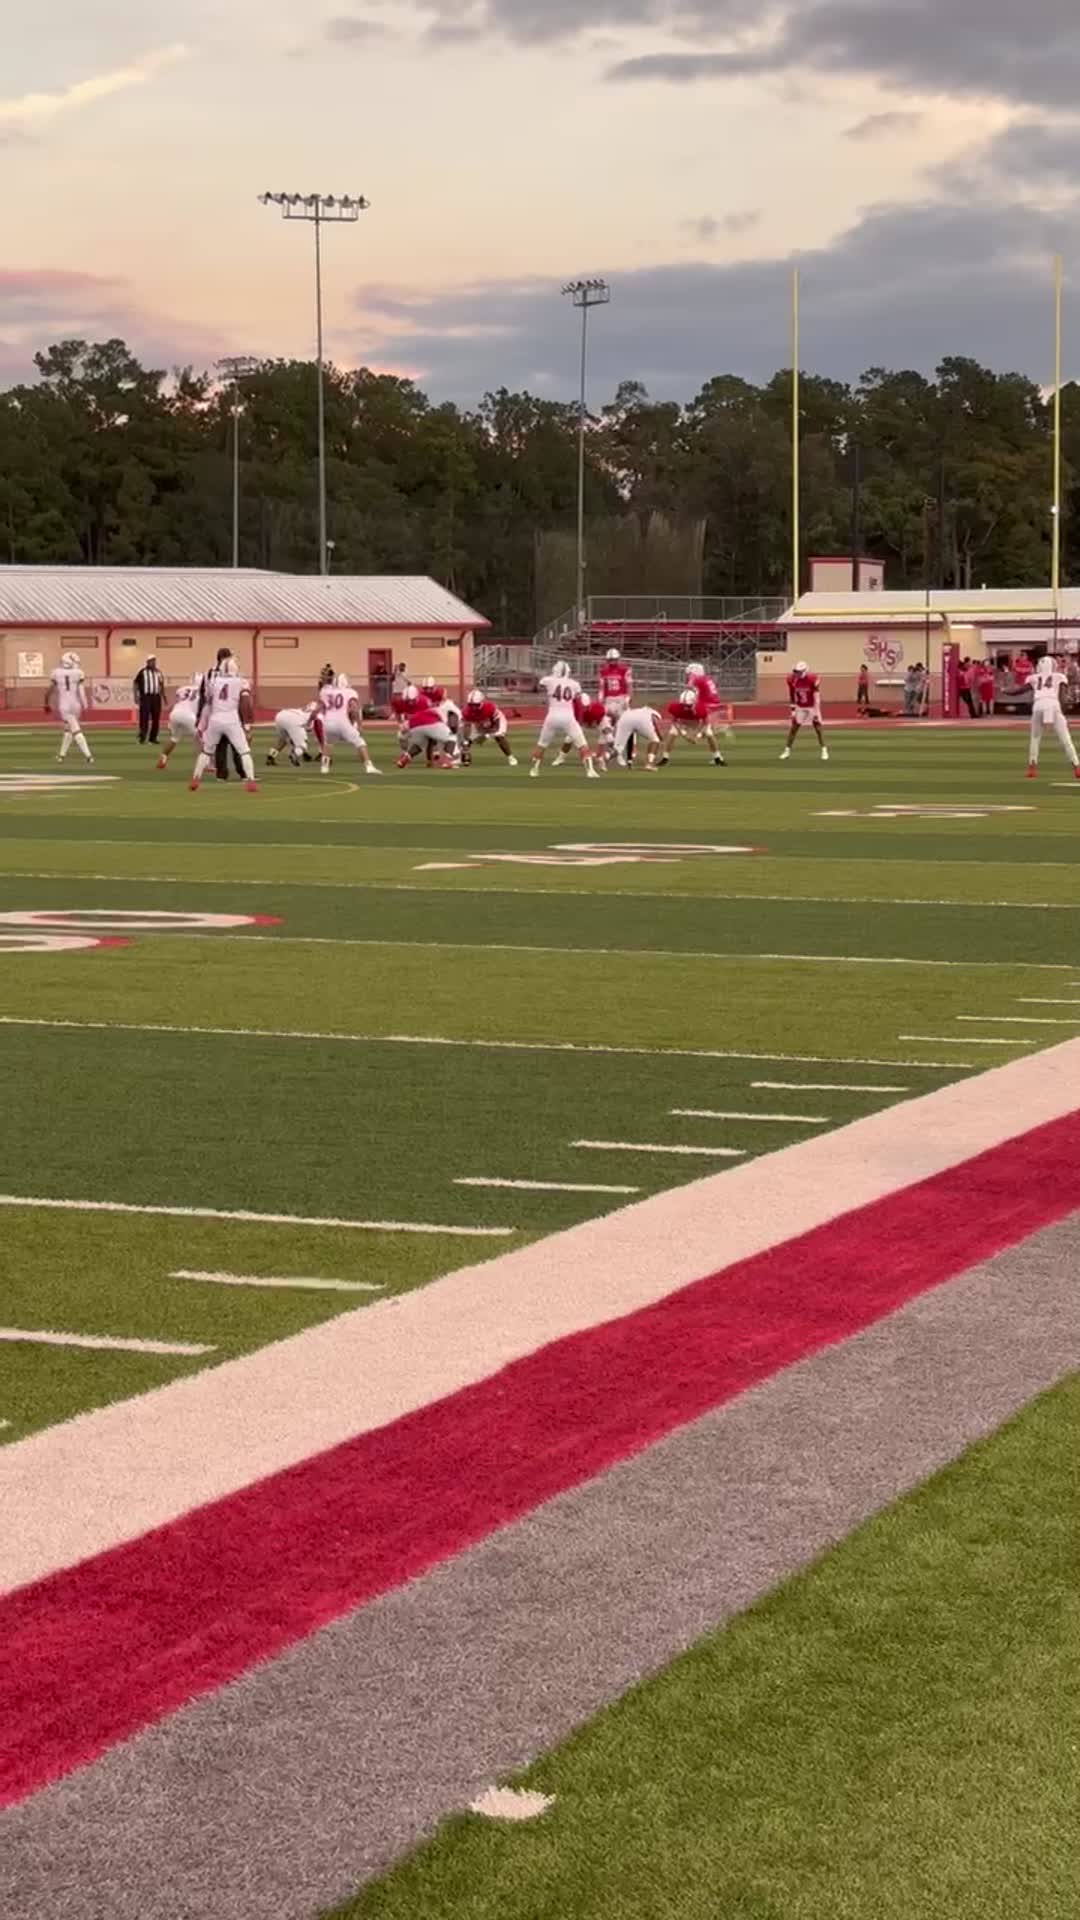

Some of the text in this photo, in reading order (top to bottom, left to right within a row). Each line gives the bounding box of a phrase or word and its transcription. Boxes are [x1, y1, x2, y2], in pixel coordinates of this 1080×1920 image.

[868, 636, 896, 665] SHS
[65, 674, 71, 692] 1
[218, 683, 229, 700] 4
[1036, 675, 1053, 691] 14
[326, 692, 344, 711] 30
[552, 683, 573, 702] 40
